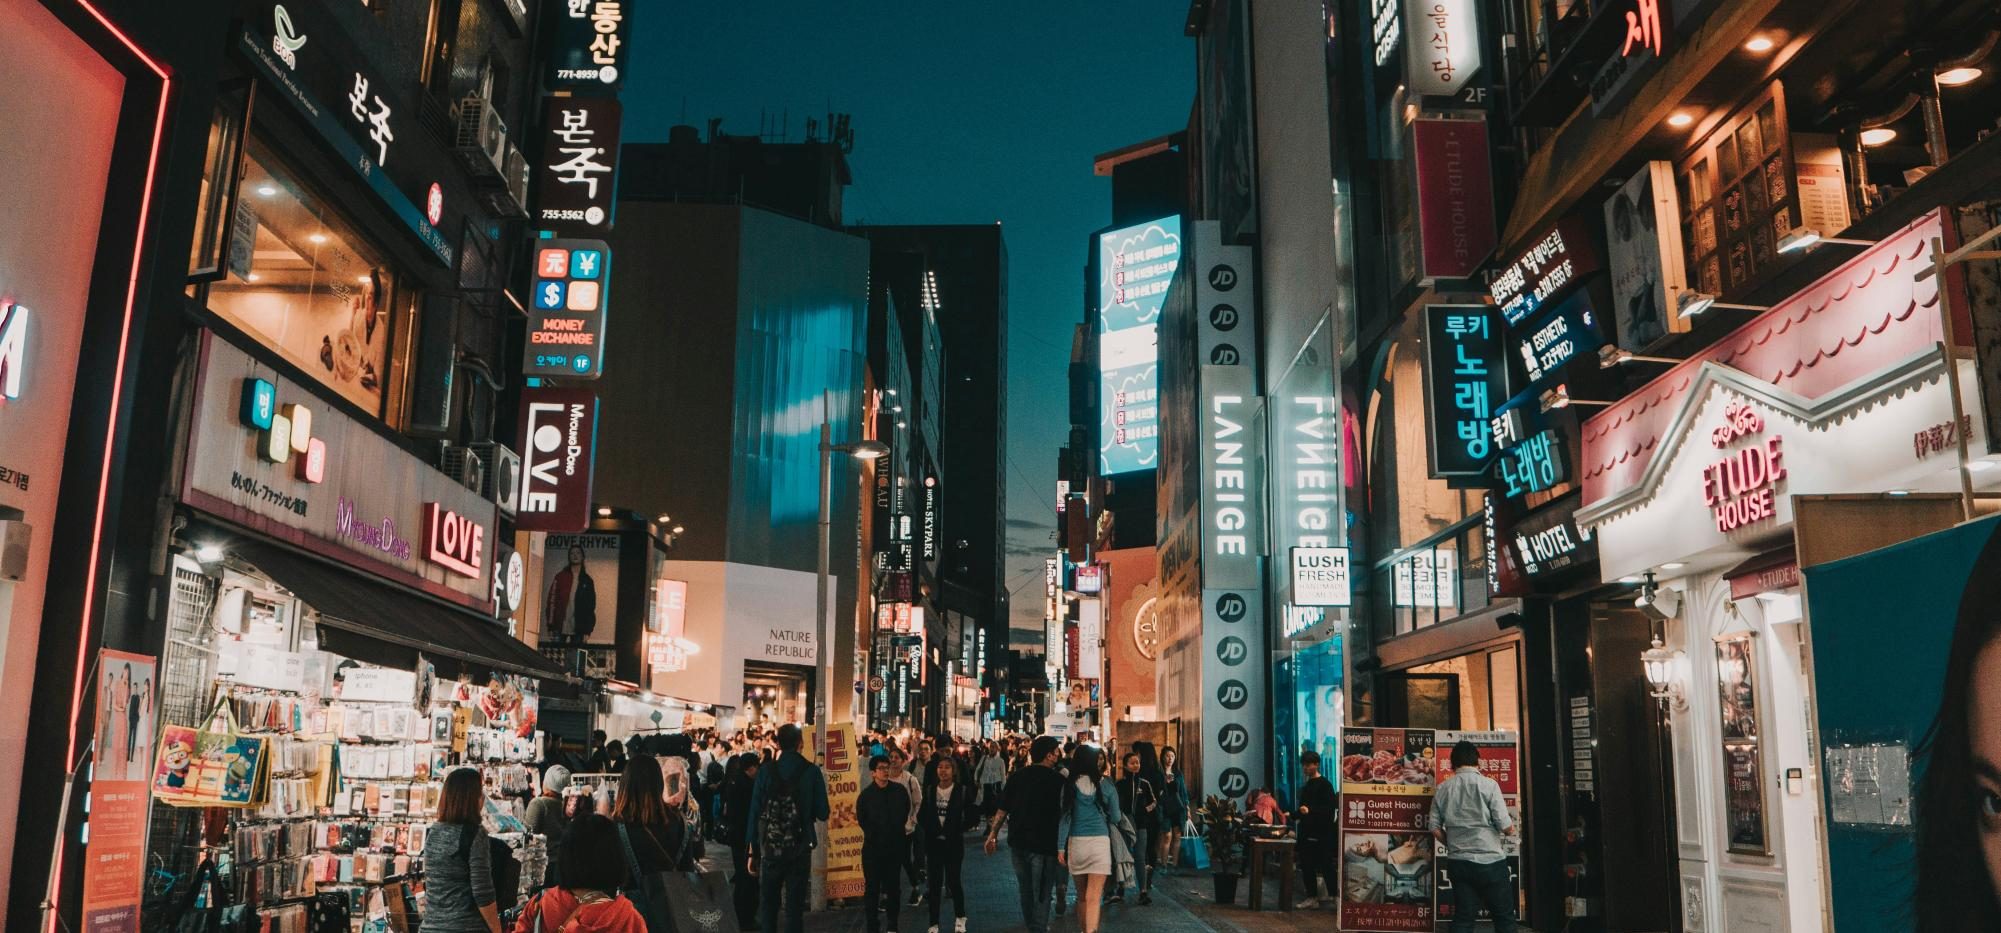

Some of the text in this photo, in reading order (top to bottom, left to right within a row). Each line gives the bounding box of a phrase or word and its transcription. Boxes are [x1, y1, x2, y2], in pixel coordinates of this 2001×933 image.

[557, 69, 599, 79] 771-8959
[1465, 87, 1488, 103] 2F
[549, 110, 612, 199] 본죽
[542, 209, 585, 221] 755-3562
[1212, 271, 1235, 286] JD
[543, 283, 560, 307] $
[543, 319, 585, 331] MONEY
[1213, 310, 1236, 326] JD
[1446, 316, 1489, 340] 루키
[1532, 315, 1567, 351] ESTHETIC
[532, 333, 593, 345] EXCHANGE
[536, 355, 588, 368] 오케이 1F
[1454, 344, 1493, 459] 노래방
[1491, 409, 1515, 450] 루키
[520, 402, 565, 513] LOVE
[1500, 432, 1554, 498] 노래방
[1214, 396, 1246, 556] LANEIGE
[1703, 434, 1788, 507] ETUDE
[1714, 488, 1777, 533] HOUSE
[430, 502, 483, 579] LOVE
[923, 511, 934, 557] SKYPARK
[1530, 523, 1576, 562] HOTEL
[1299, 556, 1344, 568] LUSH
[1299, 571, 1345, 582] FRESH
[1762, 567, 1790, 588] ETUDE
[1219, 600, 1242, 615] JD
[770, 629, 811, 643] NATURE
[766, 644, 814, 659] REPUBLIC
[1220, 644, 1243, 660] JD
[871, 679, 881, 688] 30
[1221, 687, 1244, 703] JD
[1222, 730, 1246, 747] JD
[1223, 775, 1246, 791] JD
[1367, 800, 1422, 809] Guest House
[1367, 810, 1393, 819] Hotel
[1417, 907, 1431, 918] 8F
